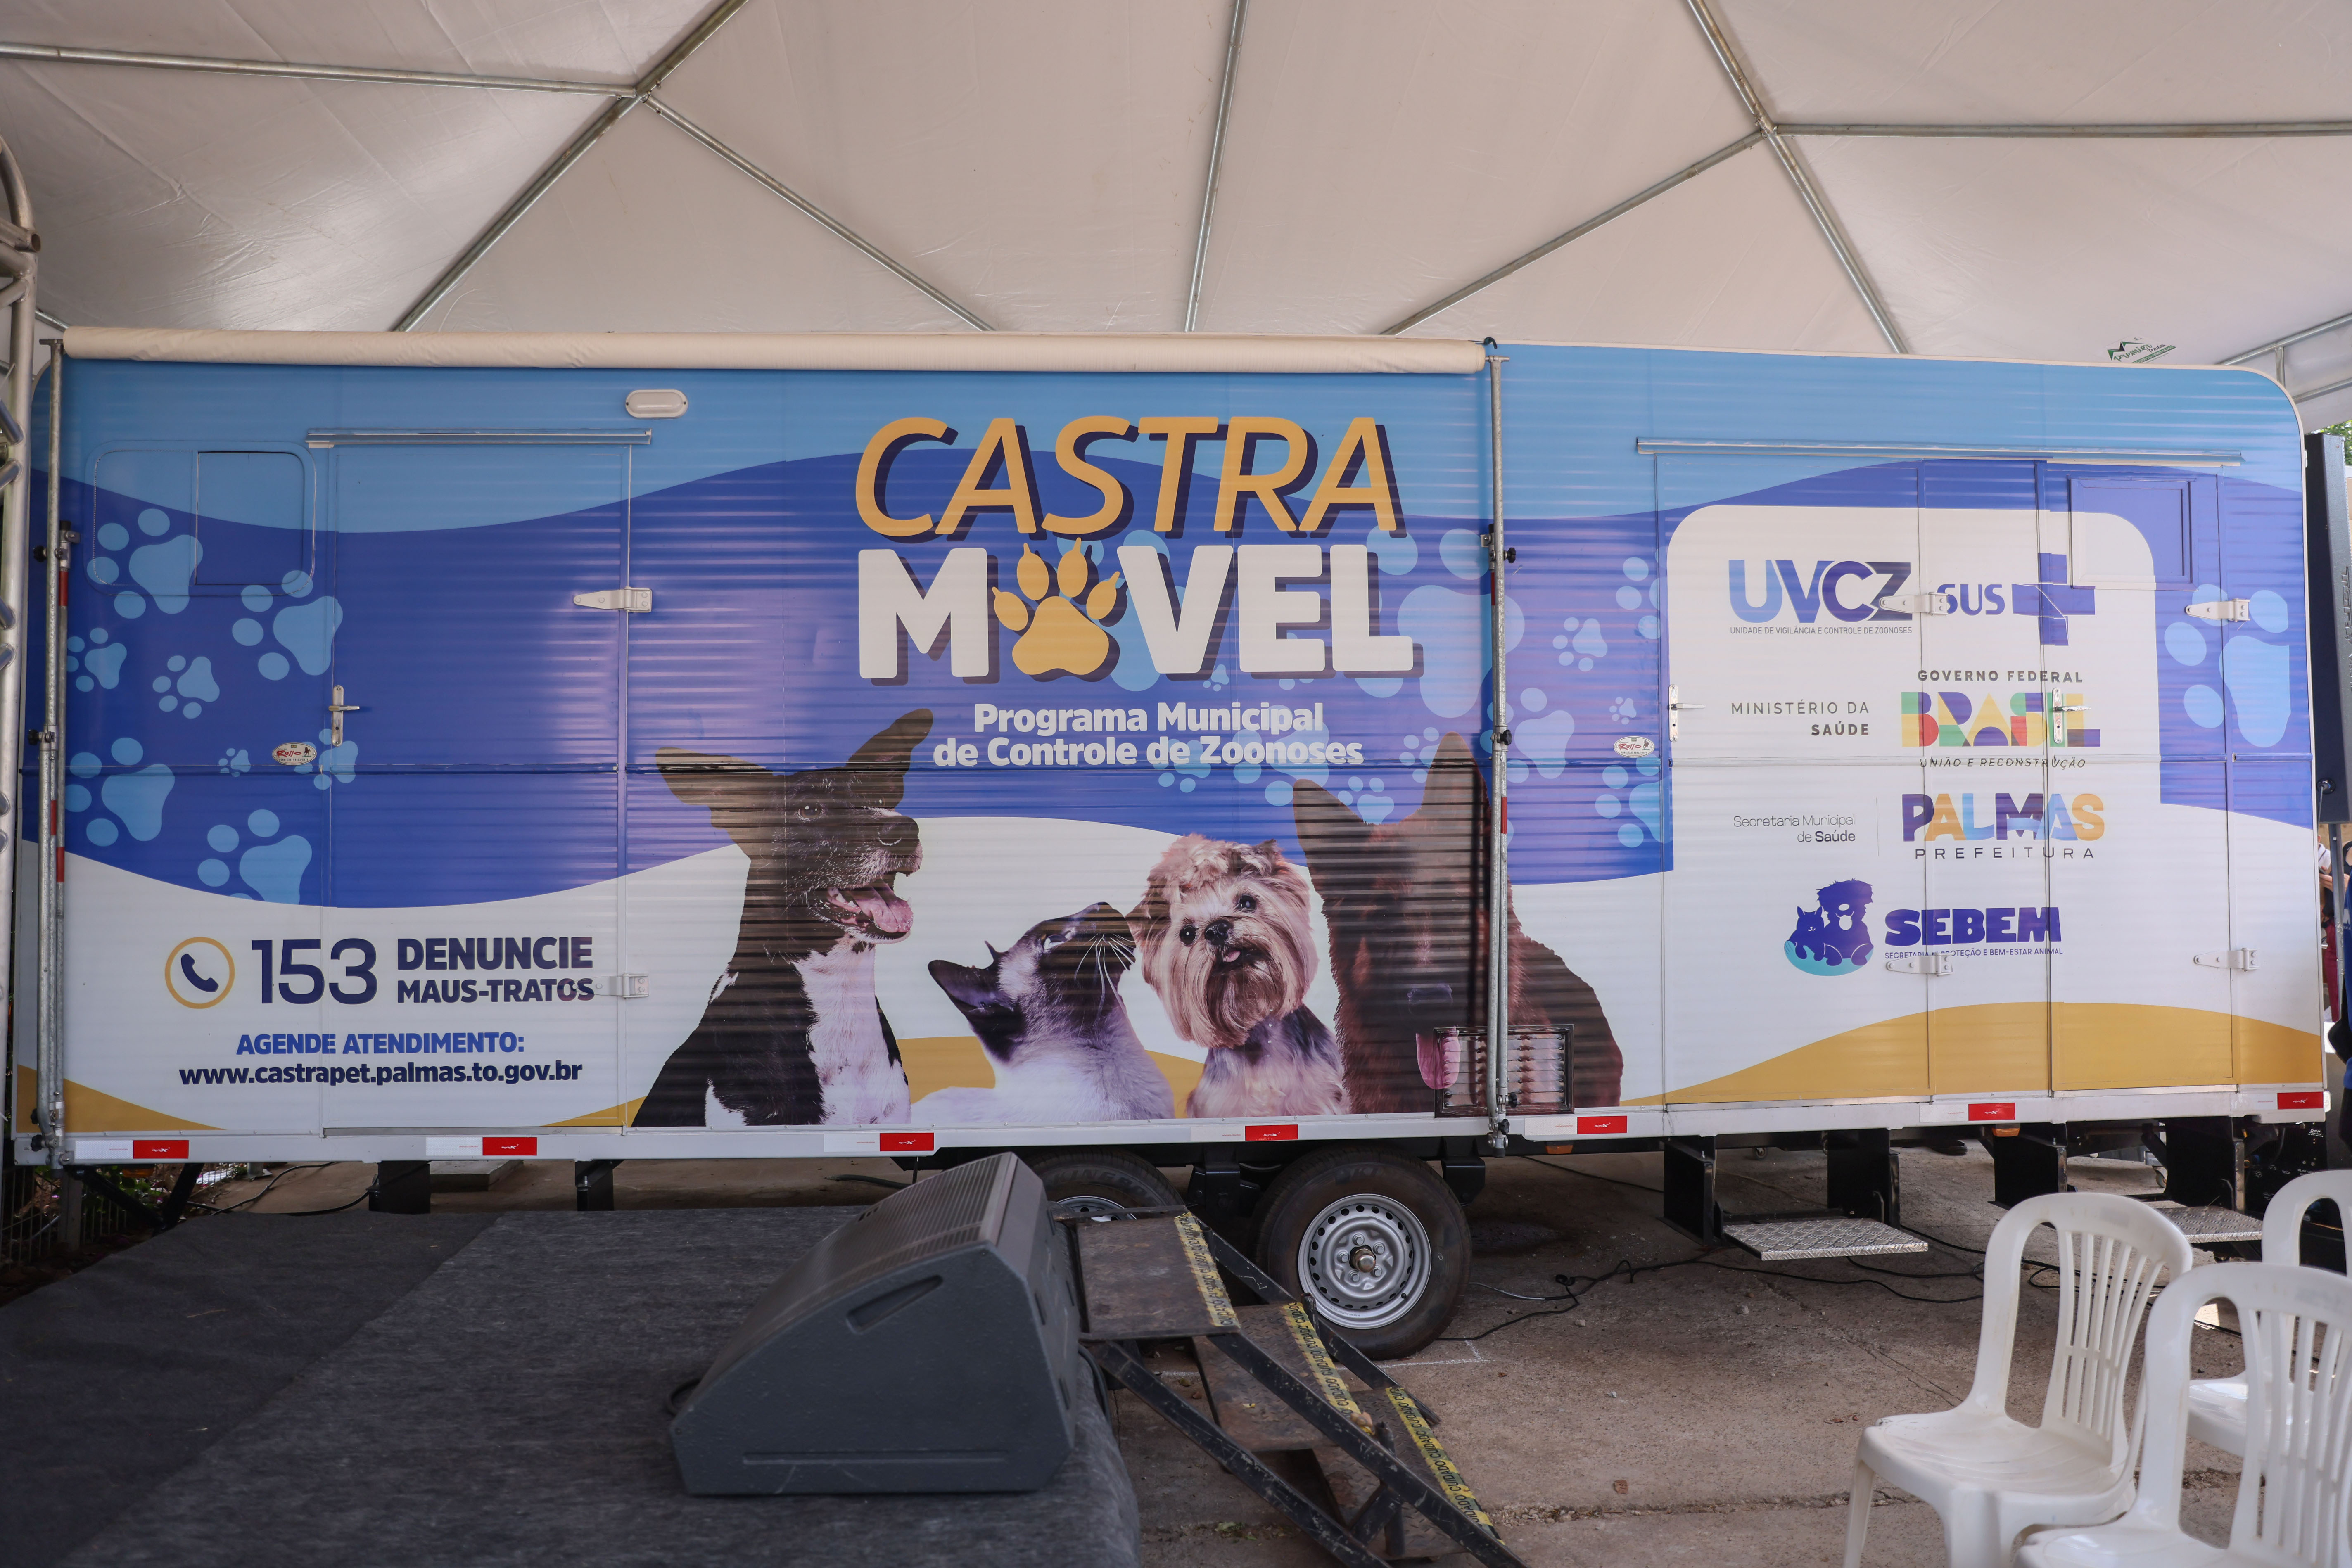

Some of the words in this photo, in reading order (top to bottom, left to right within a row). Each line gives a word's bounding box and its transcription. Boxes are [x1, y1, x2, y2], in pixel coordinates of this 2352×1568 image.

[855, 415, 1402, 538] CASTRA
[1728, 560, 1913, 623] UVCZ
[1936, 584, 2005, 616] SUS
[858, 543, 1415, 680] MVEL
[1775, 625, 1816, 634] VIGILÂNCIA
[1917, 670, 1998, 681] GOVERNO
[2007, 671, 2083, 683] FEDERAL
[973, 703, 1147, 737] Programa
[1156, 702, 1323, 735] Municipal
[1731, 699, 1838, 714] MINISTÉRIO
[1847, 702, 1869, 714] DA
[1901, 691, 2101, 747] BRASIL
[1811, 721, 1869, 736] SAÚDE
[933, 737, 978, 766] de
[985, 736, 1137, 766] Controle
[1146, 736, 1190, 766] de
[1200, 735, 1365, 765] Zoonoses
[1920, 756, 1961, 767] UNIÃO
[1967, 758, 1974, 767] E
[1980, 757, 2085, 770] RECONSTRUÇÃO
[1733, 815, 1799, 827] Secretaria
[1803, 814, 1855, 828] Municipal
[1901, 793, 2105, 842] PALMAS
[1797, 831, 1812, 842] de
[1815, 830, 1856, 842] Saúde
[1915, 847, 2094, 859] PREFEITURA
[1884, 907, 2062, 946] SEBEM
[252, 938, 377, 1005] 153
[397, 936, 593, 970] DENUNCIE
[397, 977, 595, 1003] MAUS-TRATOS
[236, 1033, 336, 1055] AGENDE
[342, 1031, 525, 1054] ATENDIMENTO:
[179, 1060, 583, 1086] www.castrapet.palmas.to.gov.br
[1213, 1300, 1233, 1325] CUIDADO
[1298, 1325, 1318, 1349] CUIDADO
[1310, 1350, 1333, 1376] CUIDADO
[1325, 1378, 1349, 1406] CUIDADO
[1398, 1402, 1422, 1428] CUIDADO
[1416, 1430, 1441, 1458] CUIDADO
[1435, 1461, 1462, 1492] CUIDADO
